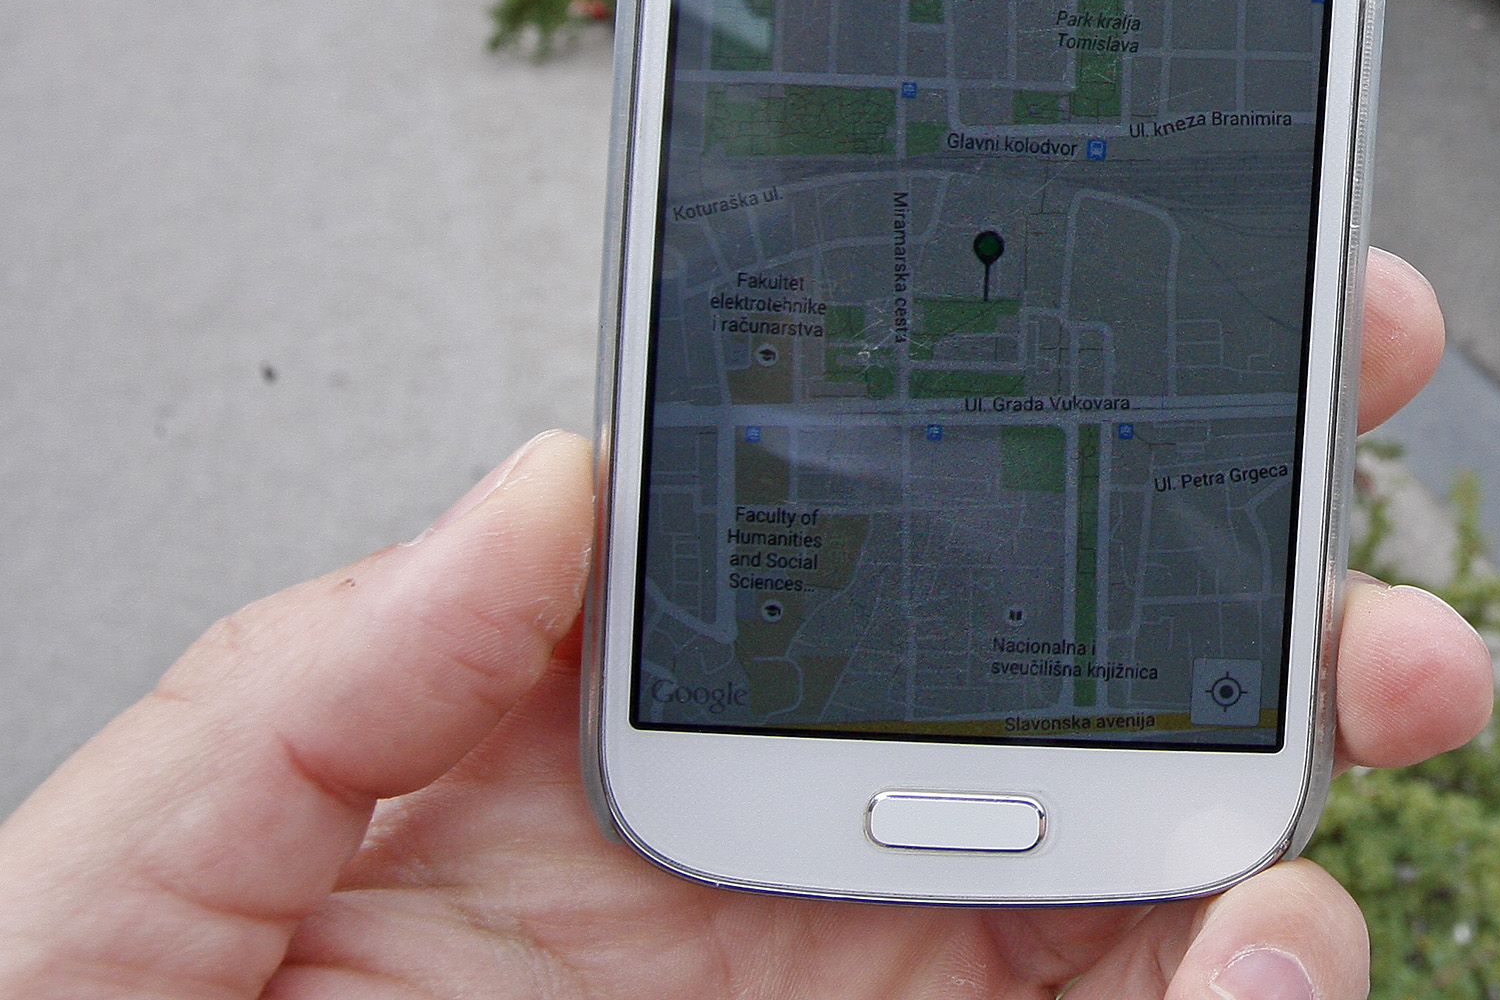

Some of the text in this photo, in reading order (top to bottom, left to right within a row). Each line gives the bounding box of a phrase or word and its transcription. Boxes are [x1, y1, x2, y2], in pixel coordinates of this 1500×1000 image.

[1055, 11, 1141, 33] Park kralja
[1056, 33, 1140, 53] Tomislava
[1154, 112, 1206, 137] kneza
[1211, 110, 1293, 128] Branimira
[946, 133, 1079, 157] Glavni kolodvor
[672, 185, 784, 222] Koturaška ul.
[894, 191, 908, 344] Miramarska cesta
[736, 272, 805, 291] Fakultet
[710, 295, 827, 316] elektrotehnike
[721, 318, 824, 338] računarstva
[992, 396, 1044, 412] Grada
[1049, 396, 1131, 412] Vukovara
[1154, 464, 1289, 492] Ul. Petra Grgeca
[734, 506, 820, 528] Faculty of
[727, 529, 823, 549] Humanities
[729, 550, 818, 570] and Social
[993, 637, 1086, 657] Nacionalna
[991, 657, 1159, 682] sveučilišna knjižnica
[651, 680, 749, 715] Google
[1004, 714, 1156, 733] Slavonska avenija
